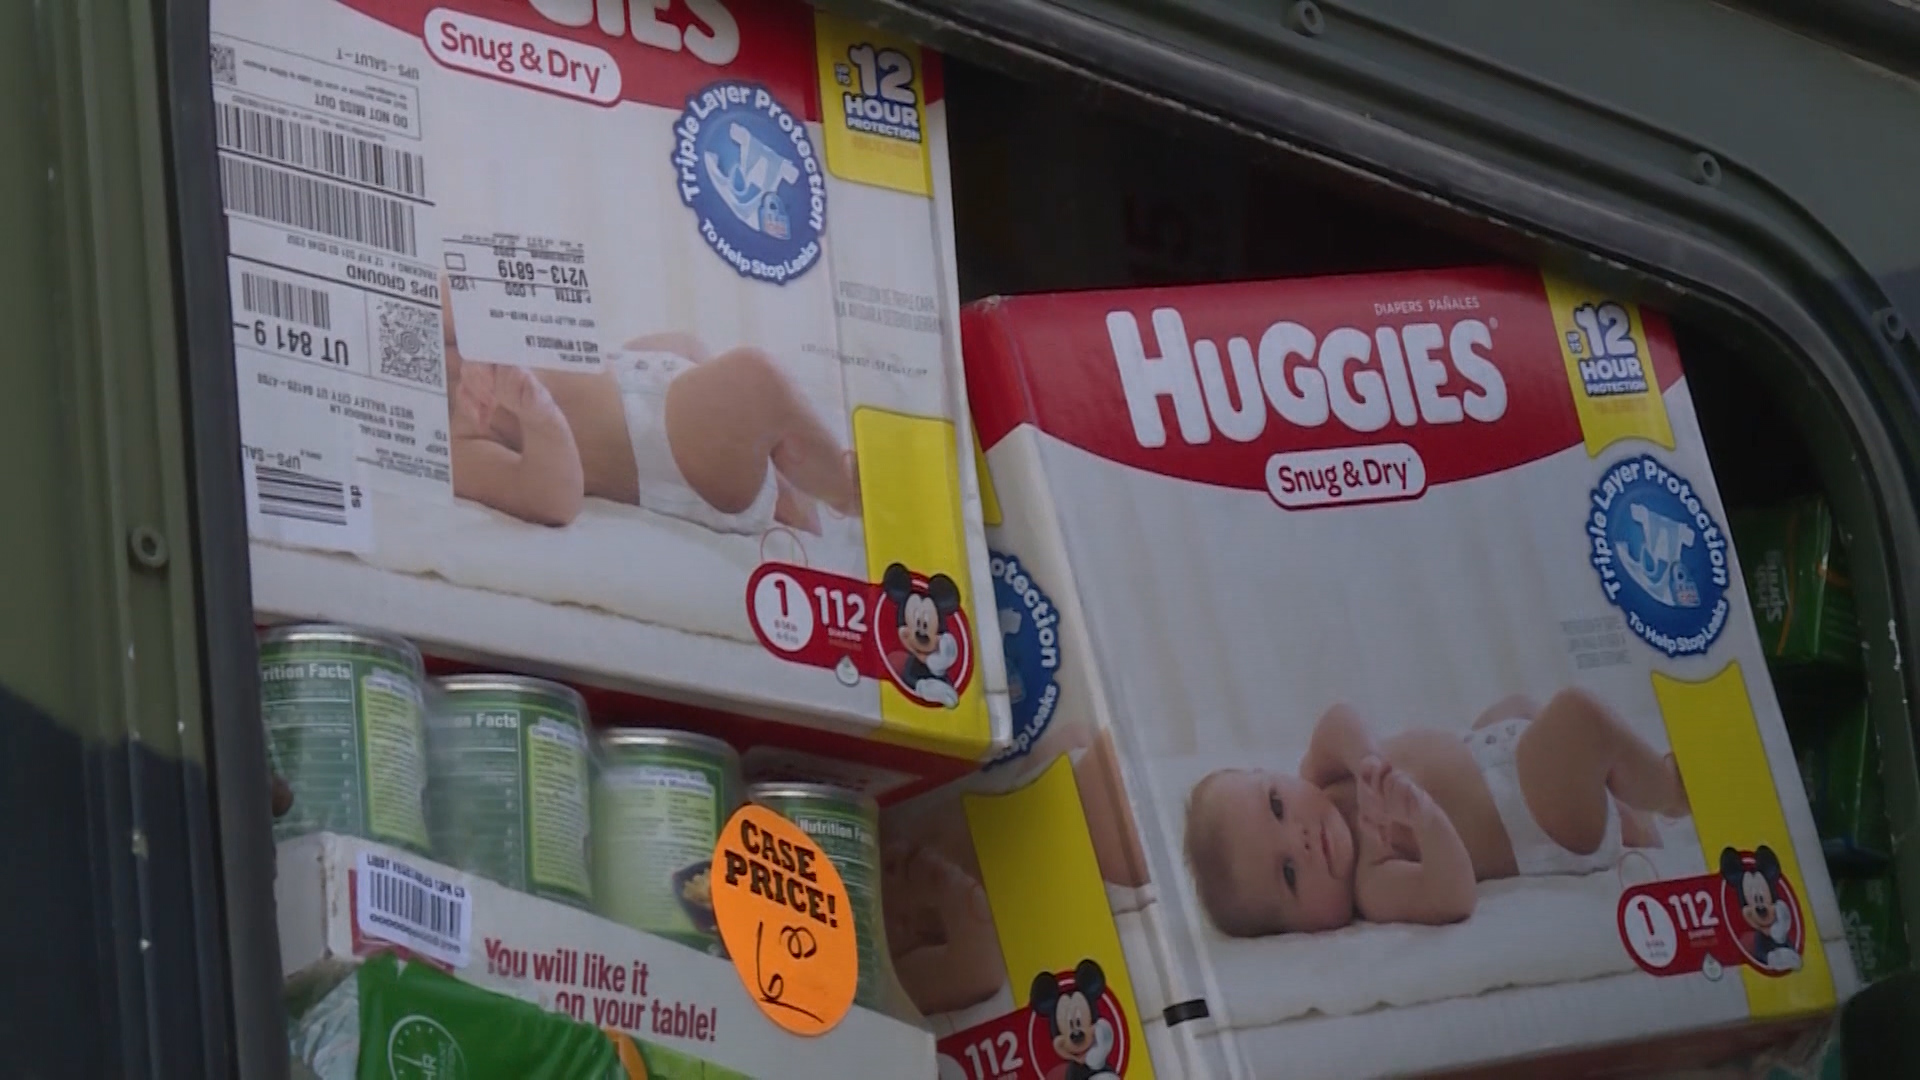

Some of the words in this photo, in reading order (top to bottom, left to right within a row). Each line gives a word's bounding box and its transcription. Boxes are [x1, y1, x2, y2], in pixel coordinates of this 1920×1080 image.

[439, 22, 515, 74] Snug
[519, 43, 544, 74] &
[547, 49, 601, 93] Dry
[849, 44, 916, 104] 12
[314, 93, 337, 111] OUT
[338, 99, 367, 119] MISS
[368, 106, 391, 125] NOT
[393, 112, 409, 130] DO
[844, 94, 919, 127] HOUR
[847, 116, 921, 141] PROTECTION
[676, 116, 701, 202] Triple
[690, 85, 751, 120] Layer
[755, 89, 827, 231] Protection
[701, 217, 717, 242] To
[717, 238, 751, 272] Help
[751, 260, 786, 280] Stop
[785, 240, 819, 274] Leaks
[345, 264, 406, 293] GROUND
[410, 280, 439, 300] UPS
[1374, 299, 1424, 317] DIAPERS
[1428, 295, 1480, 313] PAÑALES
[275, 325, 313, 357] 841
[321, 337, 350, 366] UT
[1574, 303, 1637, 357] 12
[1106, 306, 1507, 449] HUGGIES
[1579, 357, 1643, 381] HOUR
[1586, 380, 1649, 396] PROTECTION
[1278, 455, 1341, 500] Snug
[1343, 461, 1365, 488] &
[1365, 458, 1409, 491] Dry
[1594, 462, 1640, 509] Layer
[1644, 459, 1727, 586] Protection
[1589, 511, 1622, 600] Triple
[774, 579, 789, 618] 1
[813, 586, 868, 633] 112
[1629, 611, 1645, 633] To
[1645, 625, 1677, 654] Help
[1677, 634, 1706, 652] Stop
[1703, 599, 1728, 640] Leaks
[308, 662, 351, 681] Facts
[476, 712, 518, 728] Facts
[799, 817, 853, 839] Nutrition
[740, 819, 817, 884] CASE
[724, 849, 839, 929] PRICE!
[1636, 901, 1655, 936] 1
[1668, 891, 1720, 931] 112
[484, 937, 528, 978] You
[533, 948, 577, 985] will
[583, 951, 626, 992] like
[631, 959, 649, 996] it
[555, 990, 585, 1022] on
[592, 996, 646, 1031] your
[652, 999, 718, 1043] table!
[964, 1030, 1024, 1080] 112
